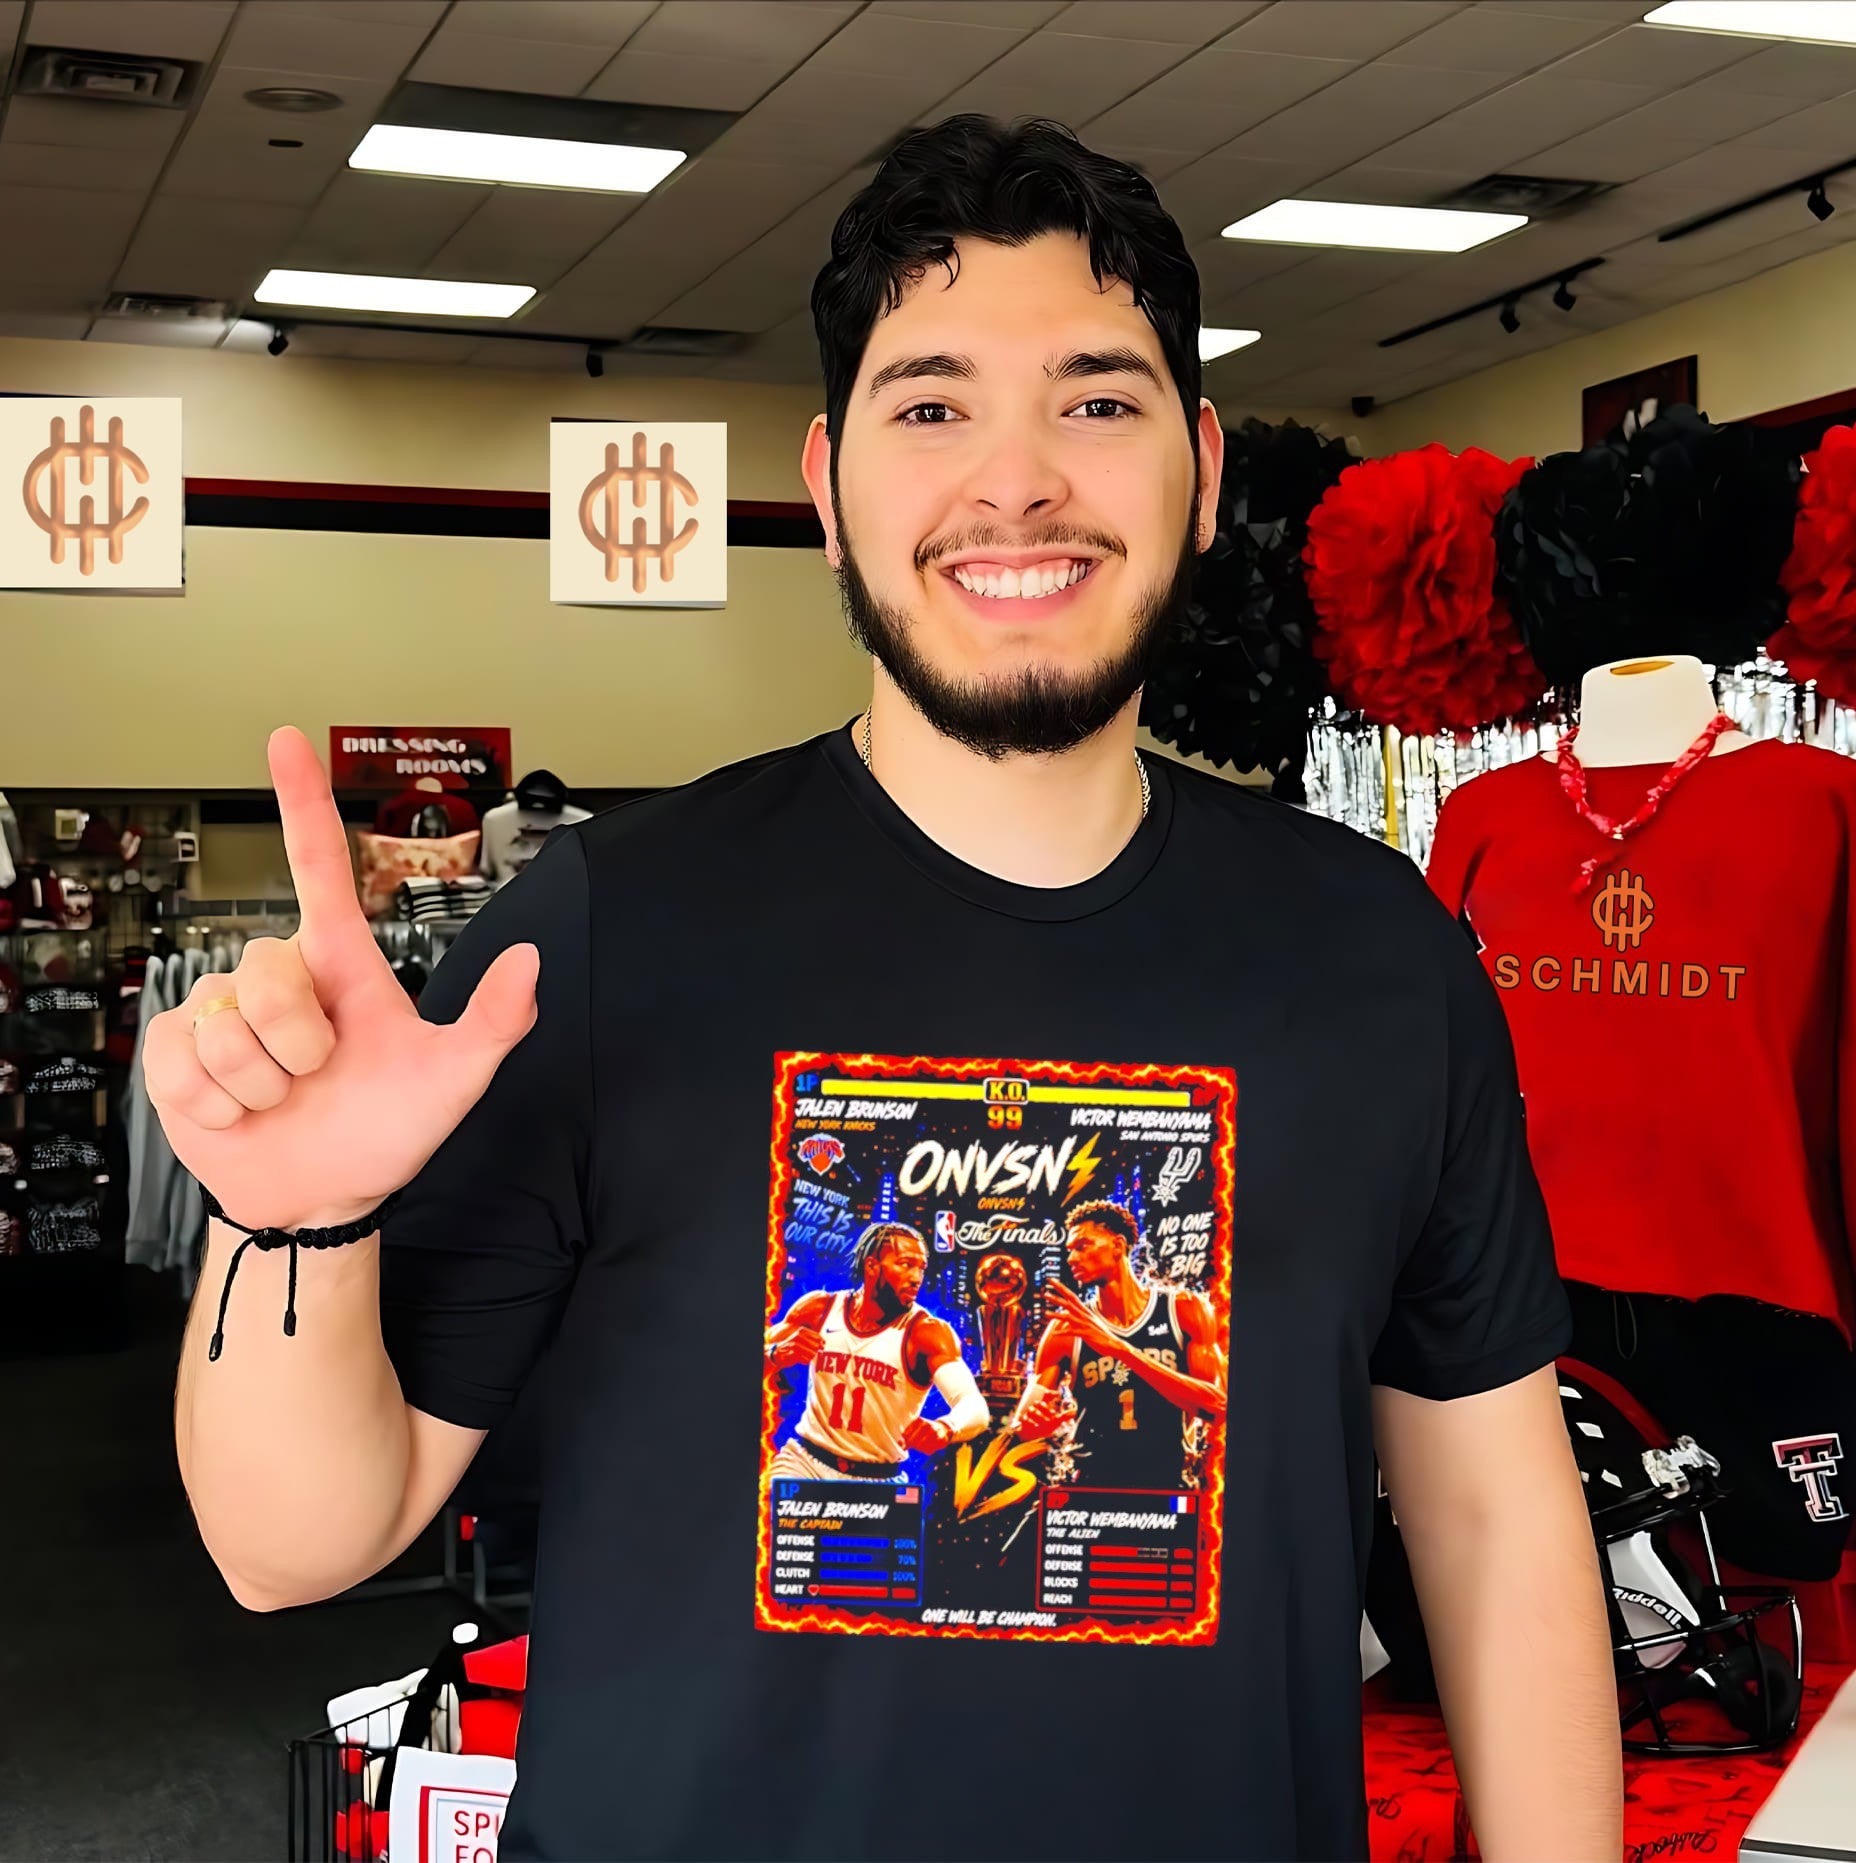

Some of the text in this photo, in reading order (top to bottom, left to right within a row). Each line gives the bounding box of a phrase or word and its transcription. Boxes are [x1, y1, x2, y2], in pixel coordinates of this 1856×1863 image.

[342, 737, 467, 753] DRESSING
[396, 759, 487, 775] ROOMS
[1494, 954, 1747, 1001] SCHMIDT
[794, 1098, 918, 1120] JALEN BRUNSON
[987, 1105, 1024, 1130] 99
[1070, 1107, 1212, 1130] VICTOR WEMBANYAMA
[793, 1178, 851, 1208] NEW YORK
[793, 1197, 854, 1233] THIS IS
[1156, 1210, 1215, 1237] NO ONE
[784, 1221, 853, 1254] OUR CITY
[955, 1213, 1066, 1250] The Finals
[1159, 1232, 1210, 1257] IS TOO
[1168, 1251, 1208, 1278] BIG
[815, 1351, 899, 1391] NEW YORK
[1082, 1347, 1179, 1388] SPRS
[828, 1382, 866, 1434] 11
[1118, 1389, 1138, 1430] 1
[953, 1429, 1050, 1524] VS
[776, 1499, 889, 1520] JALEN BRUNSON
[1045, 1509, 1178, 1530] VICTOR WEMBANYAMA
[778, 1517, 799, 1529] THE
[1046, 1527, 1067, 1538] THE
[775, 1566, 810, 1578] CLUTCH
[774, 1583, 804, 1595] HEART
[921, 1608, 949, 1623] ONE
[947, 1609, 976, 1624] WILL
[976, 1610, 998, 1625] BE
